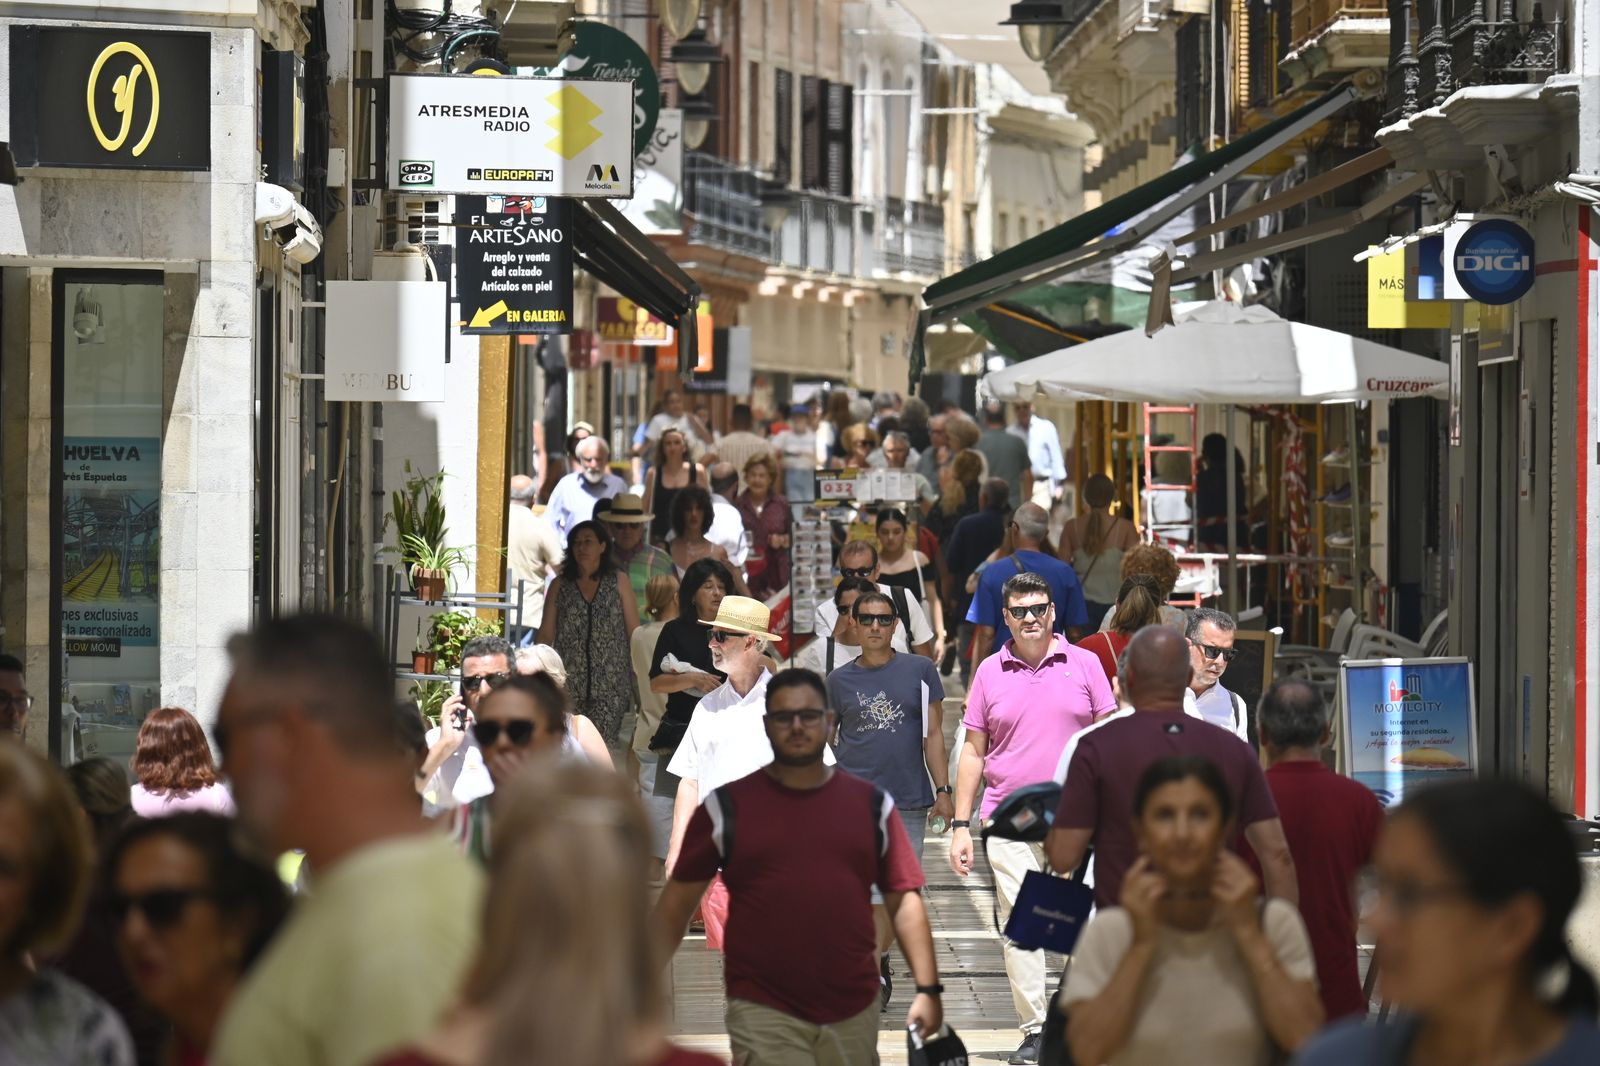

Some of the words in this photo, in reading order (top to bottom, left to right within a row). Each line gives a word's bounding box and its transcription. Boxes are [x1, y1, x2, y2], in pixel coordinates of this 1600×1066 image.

[418, 104, 530, 119] ATRESMEDIA
[484, 120, 531, 132] RADIO
[405, 174, 431, 182] CERO
[483, 250, 516, 265] Arreglo
[518, 253, 525, 264] y
[525, 252, 551, 262] venta
[1457, 255, 1530, 271] DIGI
[491, 265, 506, 277] del
[508, 265, 543, 277] calzado
[481, 280, 520, 292] Artículos
[521, 283, 533, 292] en
[535, 279, 553, 294] piel
[1379, 275, 1405, 290] MÁS
[506, 310, 521, 322] EN
[523, 309, 566, 322] GALERIA
[600, 321, 667, 340] TABACOS
[1366, 377, 1436, 392] Cruzcam
[64, 445, 140, 461] HUELVA
[80, 463, 91, 471] de
[83, 472, 128, 484] Espuelas
[84, 608, 139, 621] exclusivas
[79, 624, 152, 637] personalizada
[1374, 702, 1443, 714] MOVILCITY
[1380, 729, 1410, 738] segunda
